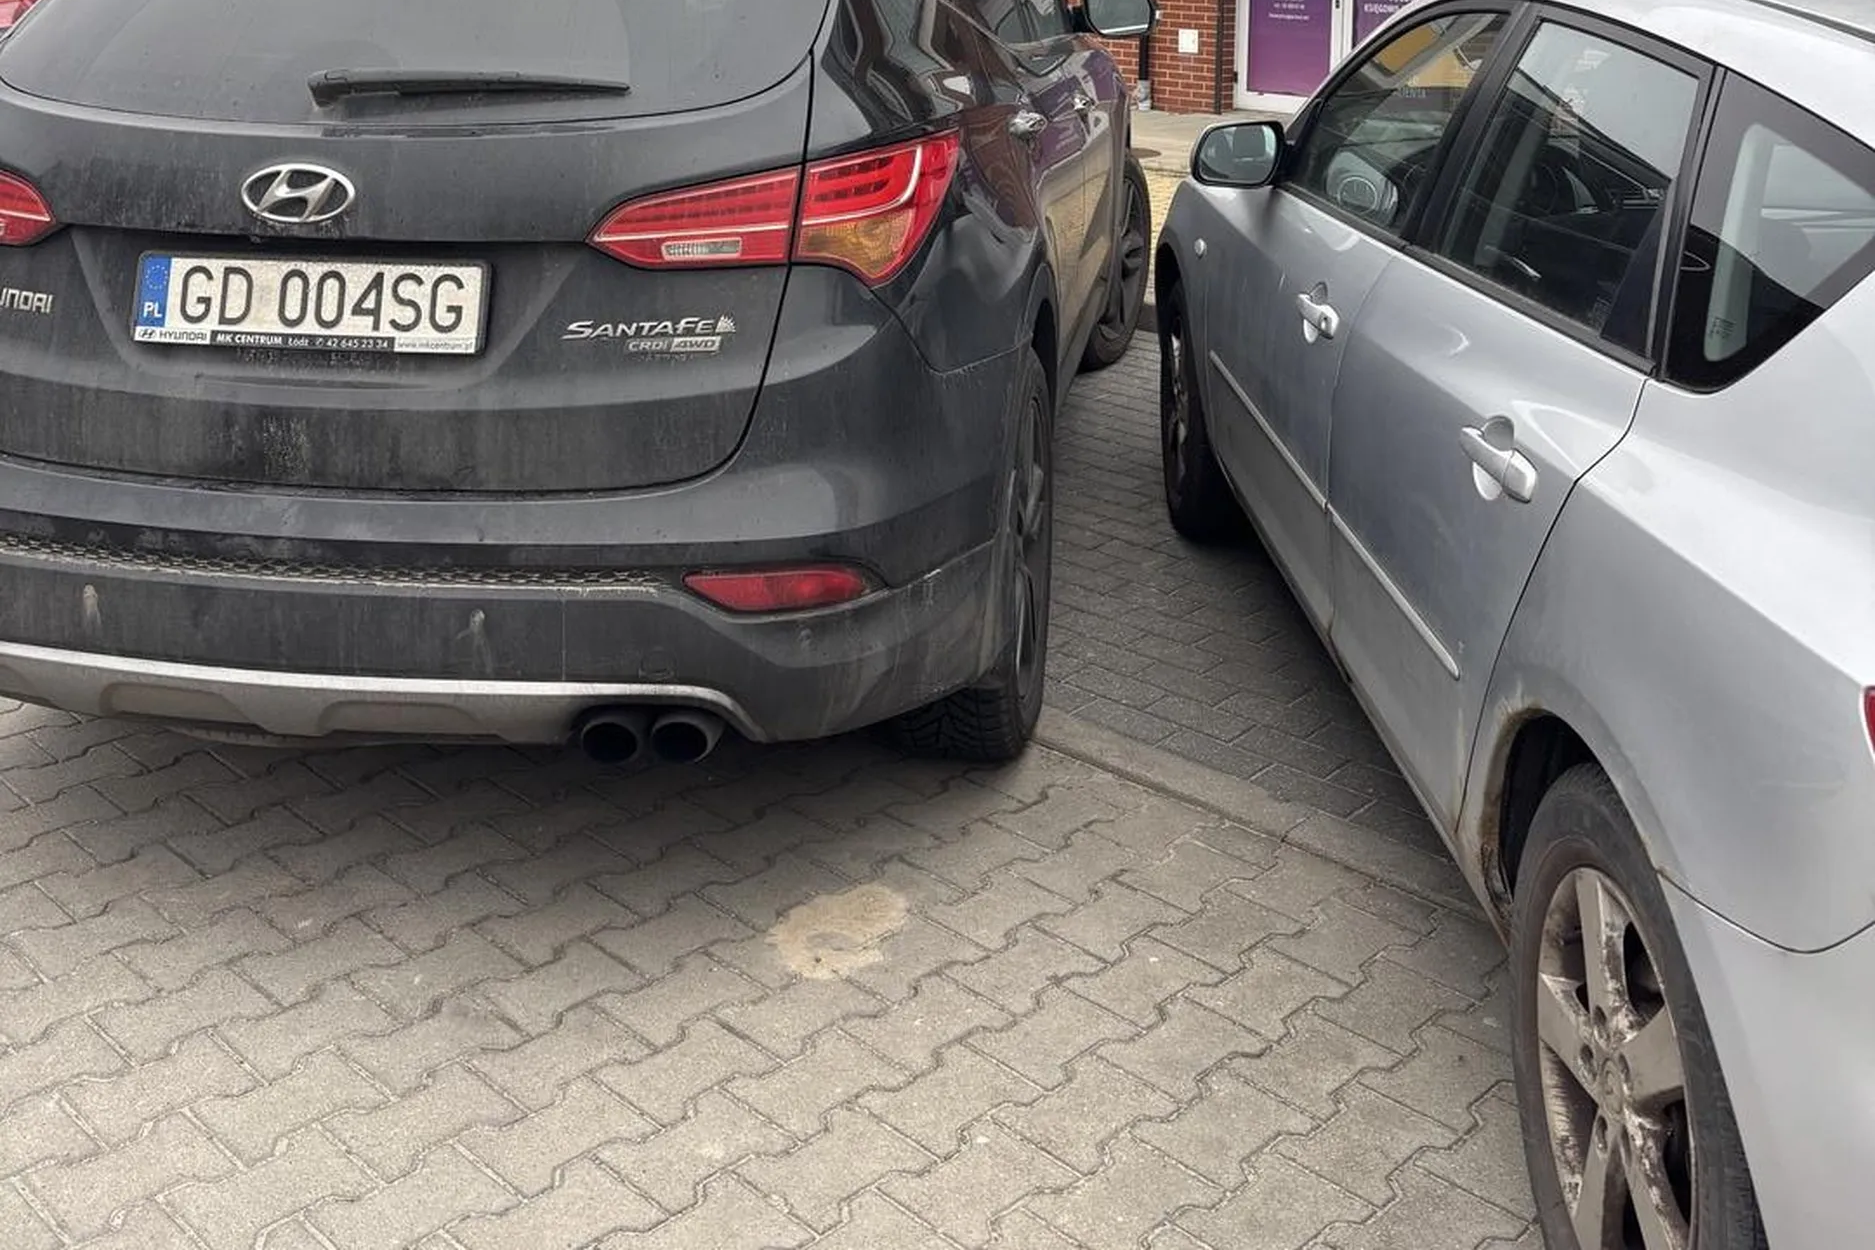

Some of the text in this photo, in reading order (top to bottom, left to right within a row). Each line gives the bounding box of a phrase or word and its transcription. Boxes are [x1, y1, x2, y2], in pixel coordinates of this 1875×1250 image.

[143, 265, 465, 334] PL GD 004SG
[159, 331, 207, 342] HYUNDAI
[216, 333, 233, 343] MK
[234, 334, 282, 345] CENTRUM
[675, 338, 718, 350] 4WD
